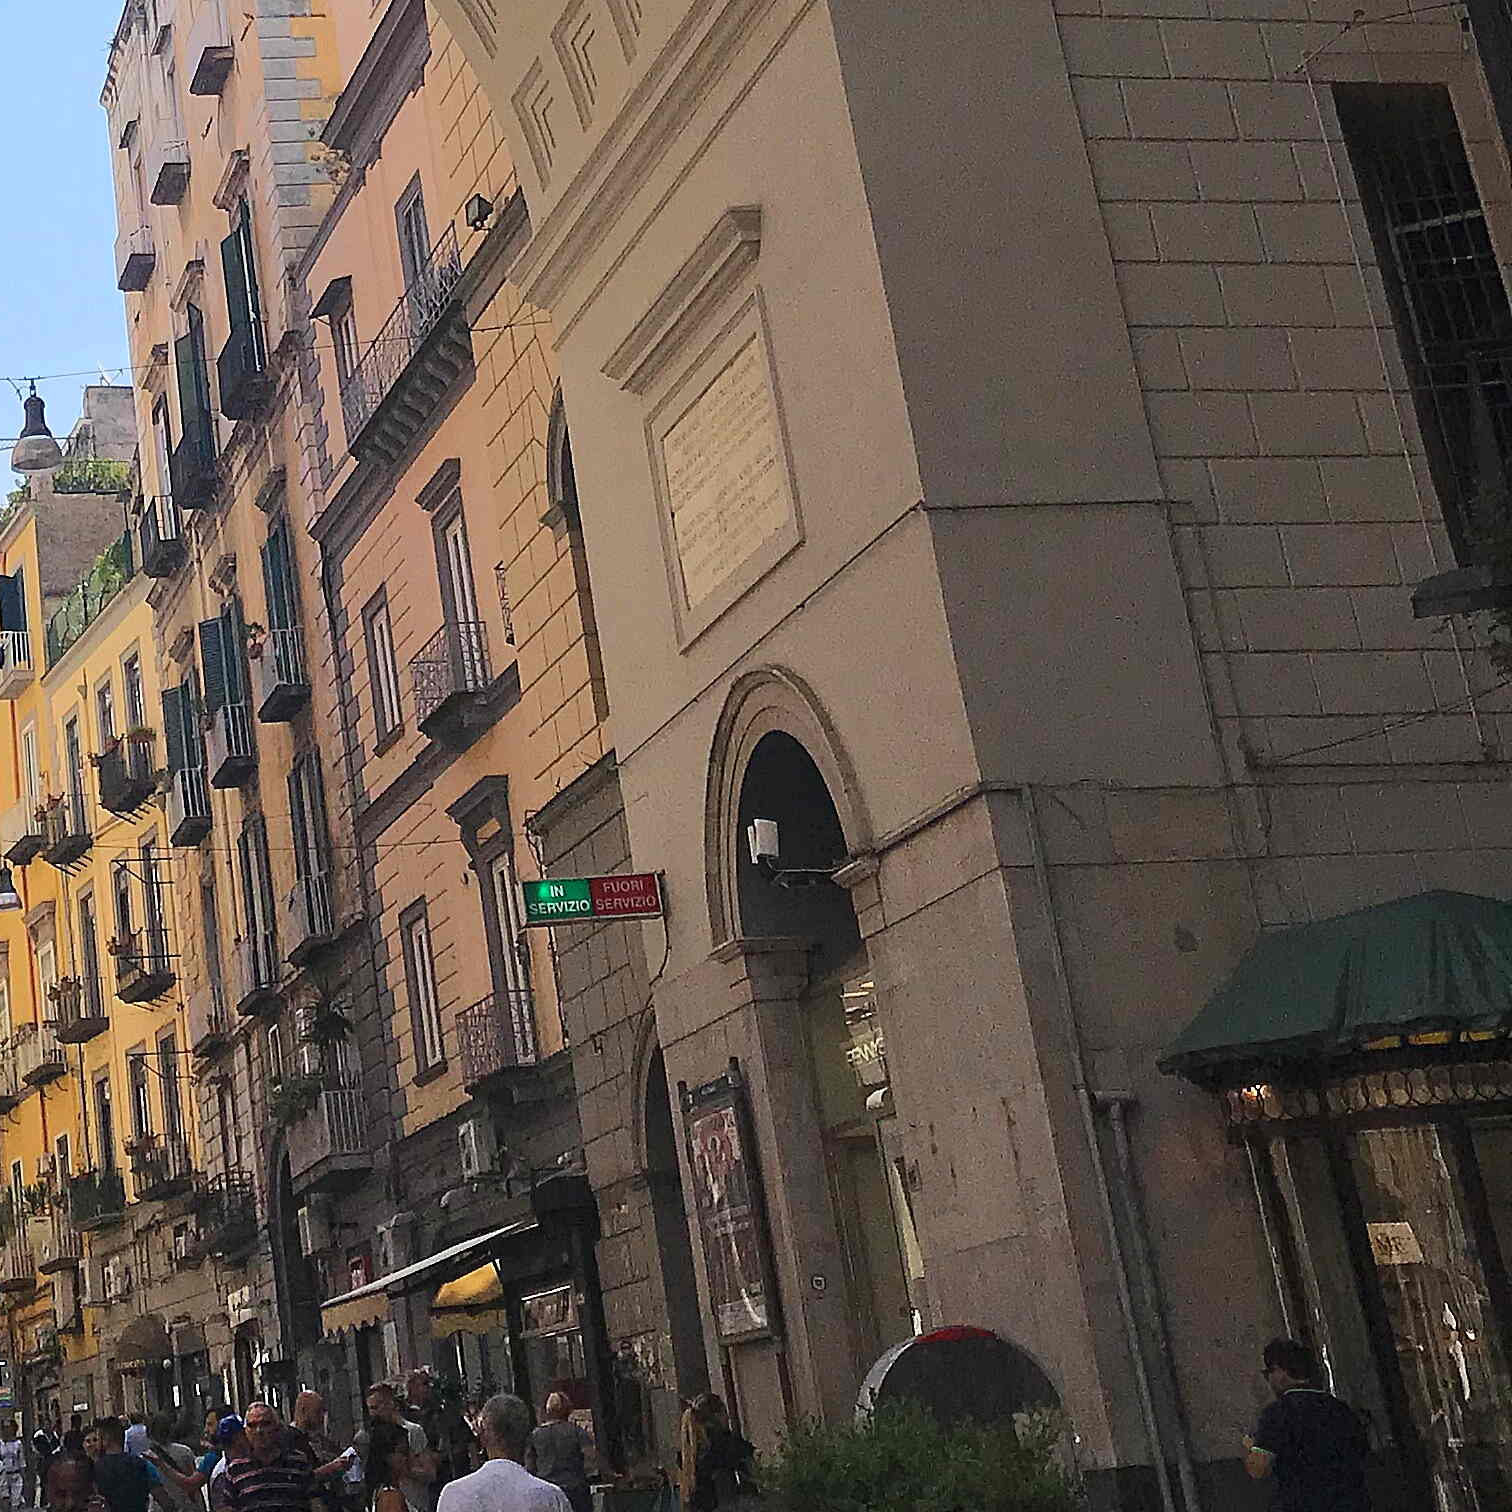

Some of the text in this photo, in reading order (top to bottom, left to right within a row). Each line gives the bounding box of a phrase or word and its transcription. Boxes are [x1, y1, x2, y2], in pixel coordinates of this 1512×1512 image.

[549, 885, 565, 898] IN
[602, 879, 644, 893] FUORI
[528, 899, 591, 916] SERVIZIO
[595, 894, 657, 911] SERVIZIO
